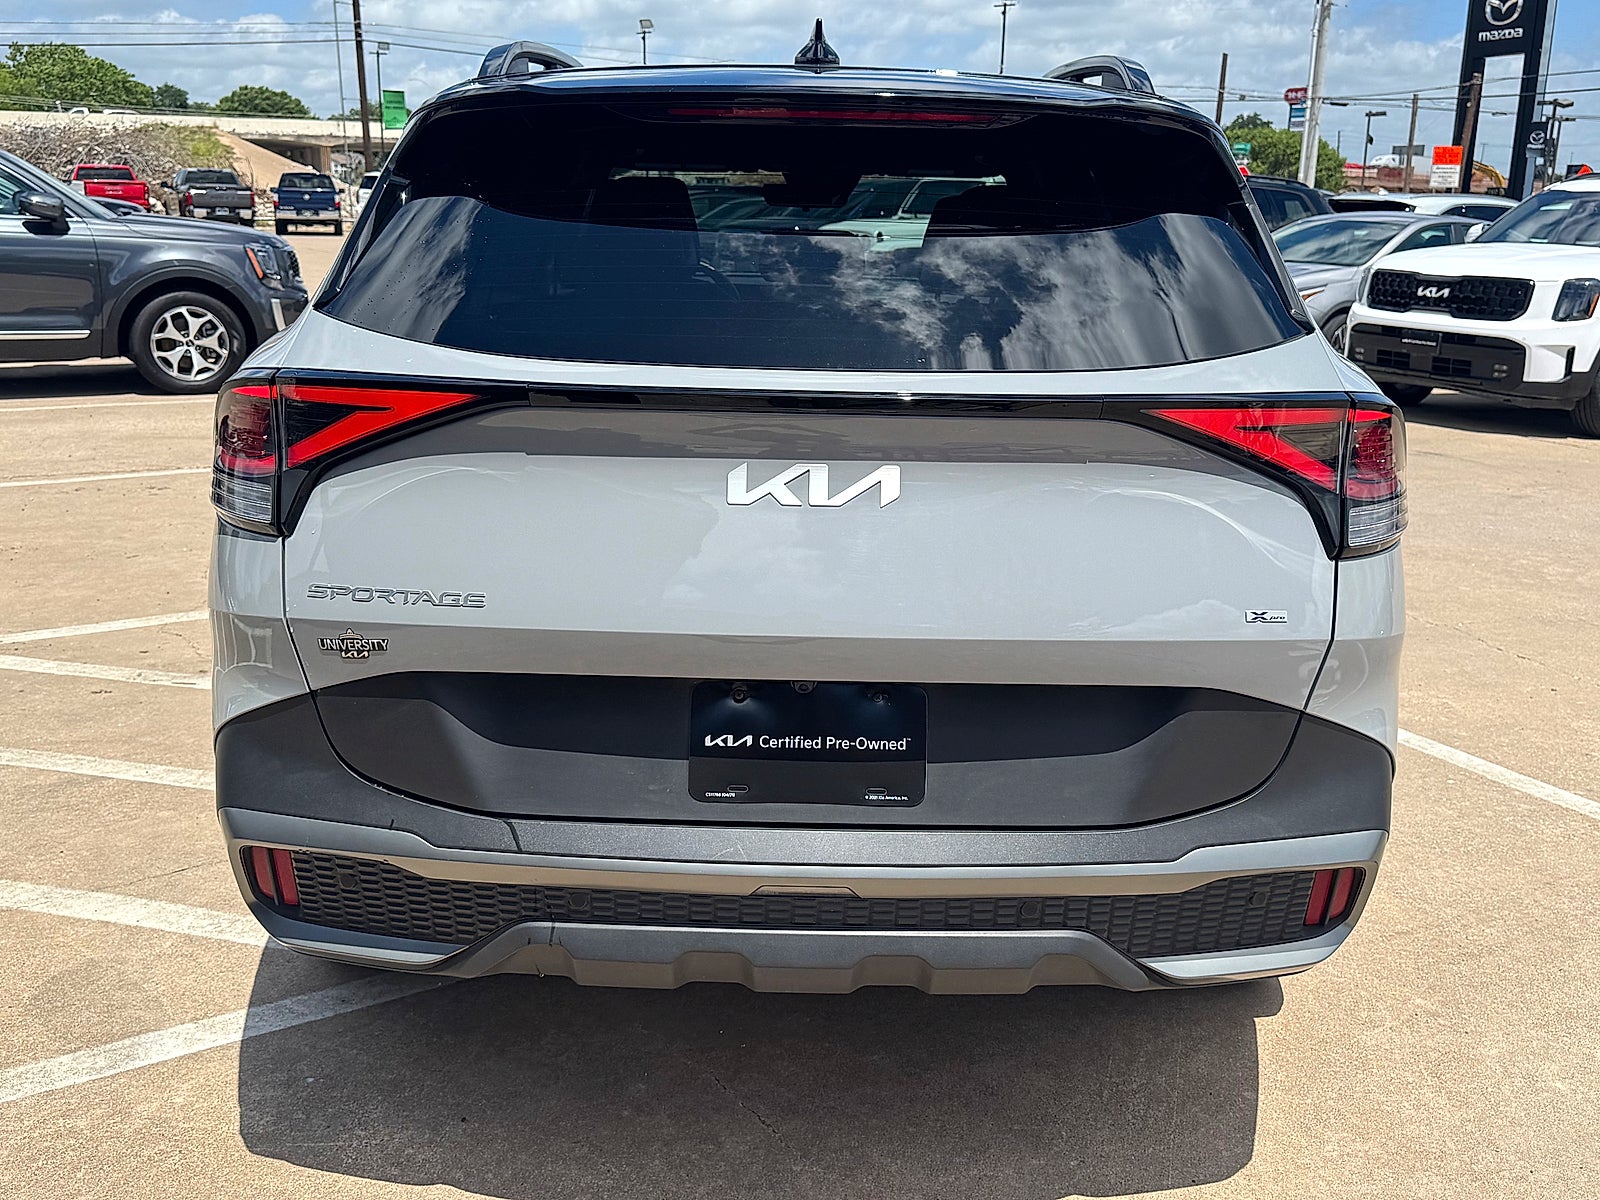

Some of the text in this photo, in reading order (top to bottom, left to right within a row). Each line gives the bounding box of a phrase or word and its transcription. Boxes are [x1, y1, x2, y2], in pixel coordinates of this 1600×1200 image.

[1417, 286, 1450, 298] KIA
[727, 462, 900, 508] KIA
[307, 583, 486, 608] SPORTAGE
[318, 638, 388, 650] UNIVERSITY
[705, 735, 752, 747] KIA
[760, 735, 821, 749] Certified
